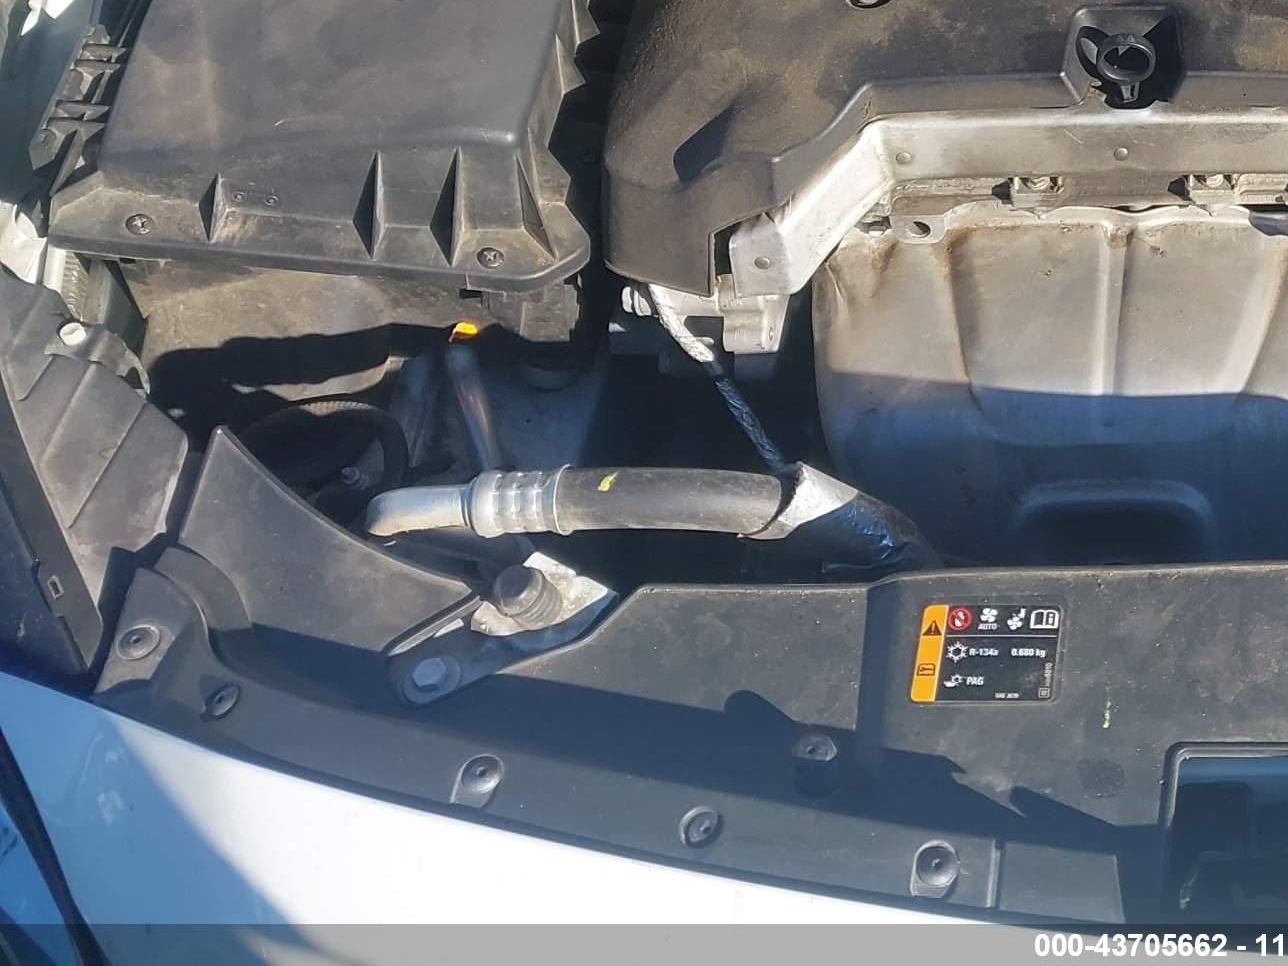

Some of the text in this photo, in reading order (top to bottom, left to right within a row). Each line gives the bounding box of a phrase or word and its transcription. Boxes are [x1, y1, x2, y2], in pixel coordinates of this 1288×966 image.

[977, 622, 998, 631] AUTO
[968, 648, 999, 657] R-134a
[1035, 648, 1047, 658] kg
[966, 676, 985, 686] PAG
